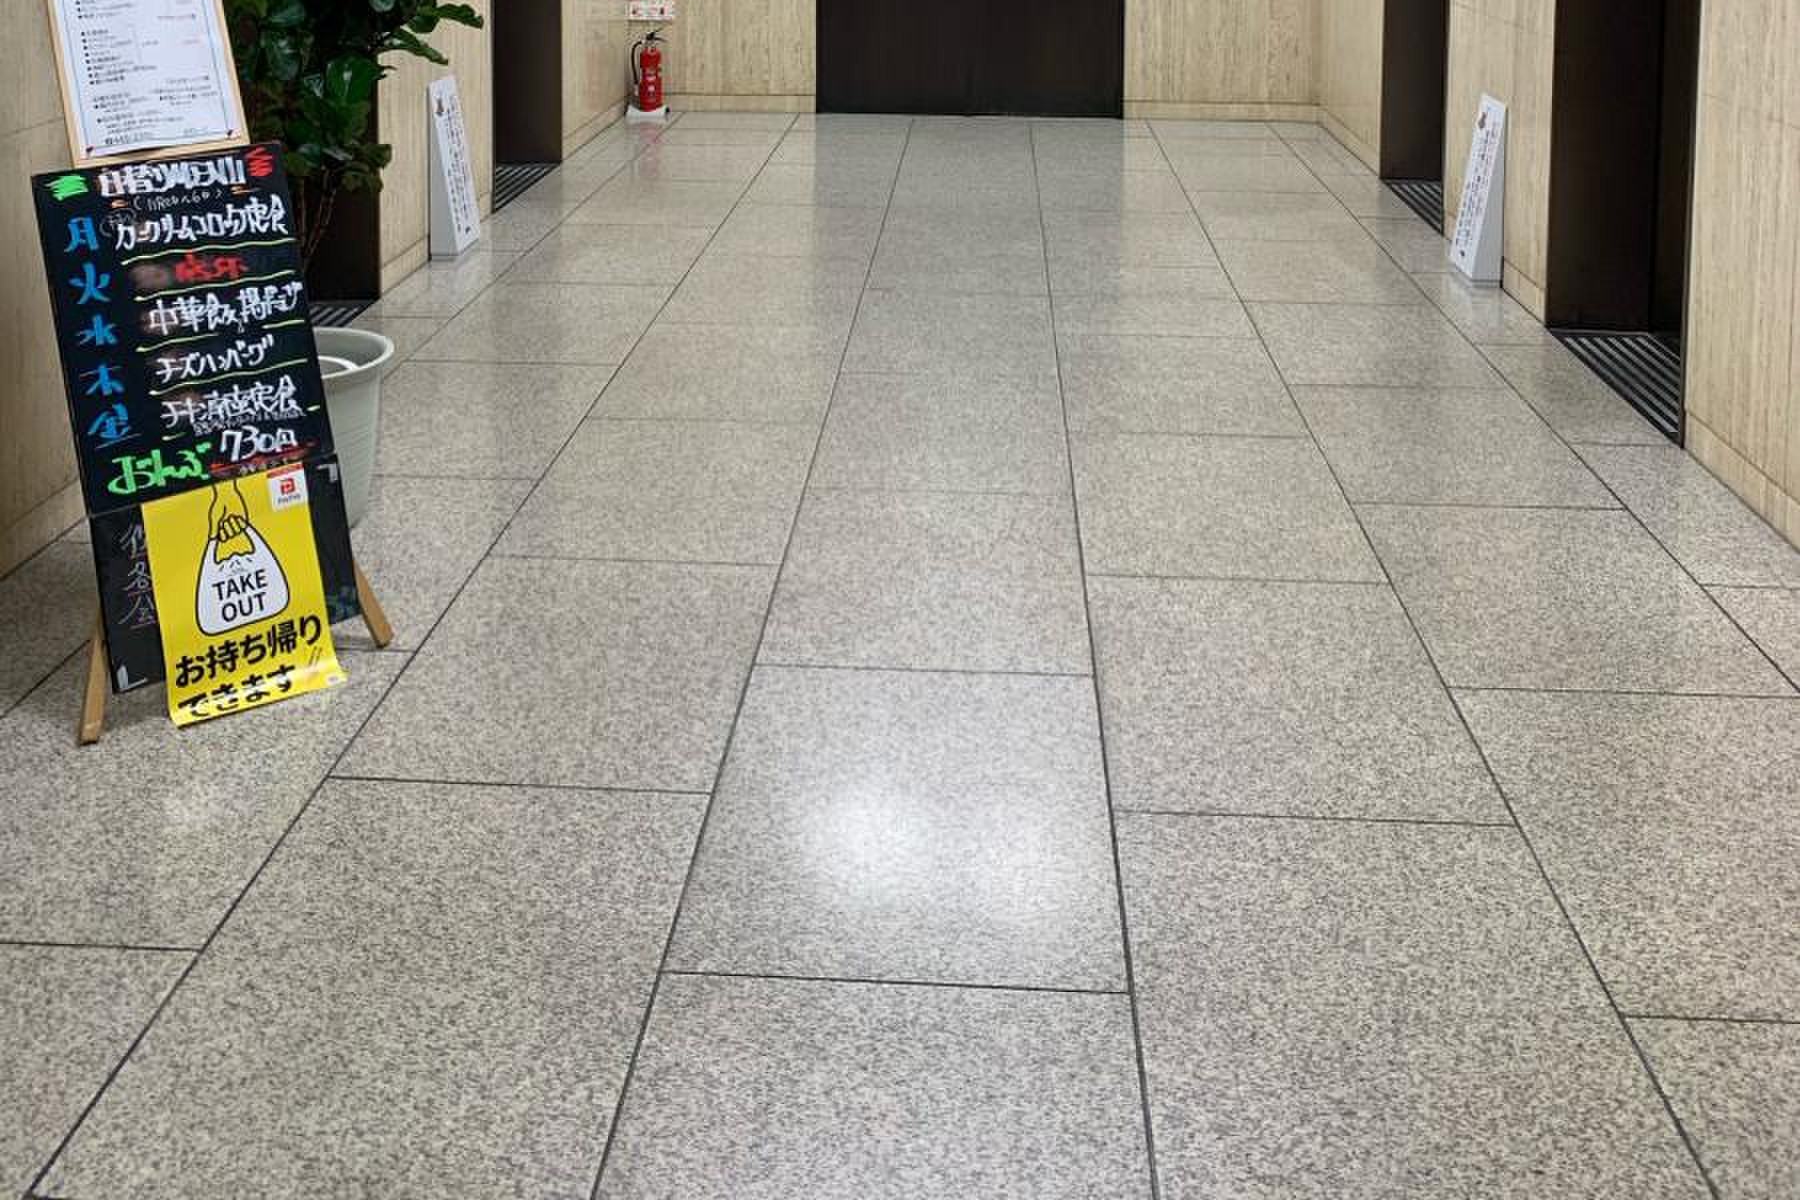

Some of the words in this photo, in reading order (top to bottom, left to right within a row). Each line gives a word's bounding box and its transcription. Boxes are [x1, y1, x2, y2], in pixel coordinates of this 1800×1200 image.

[64, 216, 99, 252] 月
[68, 262, 111, 304] 火
[75, 314, 118, 346] 水
[80, 364, 124, 396] 木
[87, 403, 130, 441] 金
[212, 569, 268, 601] TAKE
[221, 593, 267, 623] OUT
[175, 615, 322, 688] お持ち帰り
[177, 664, 296, 717] できます
